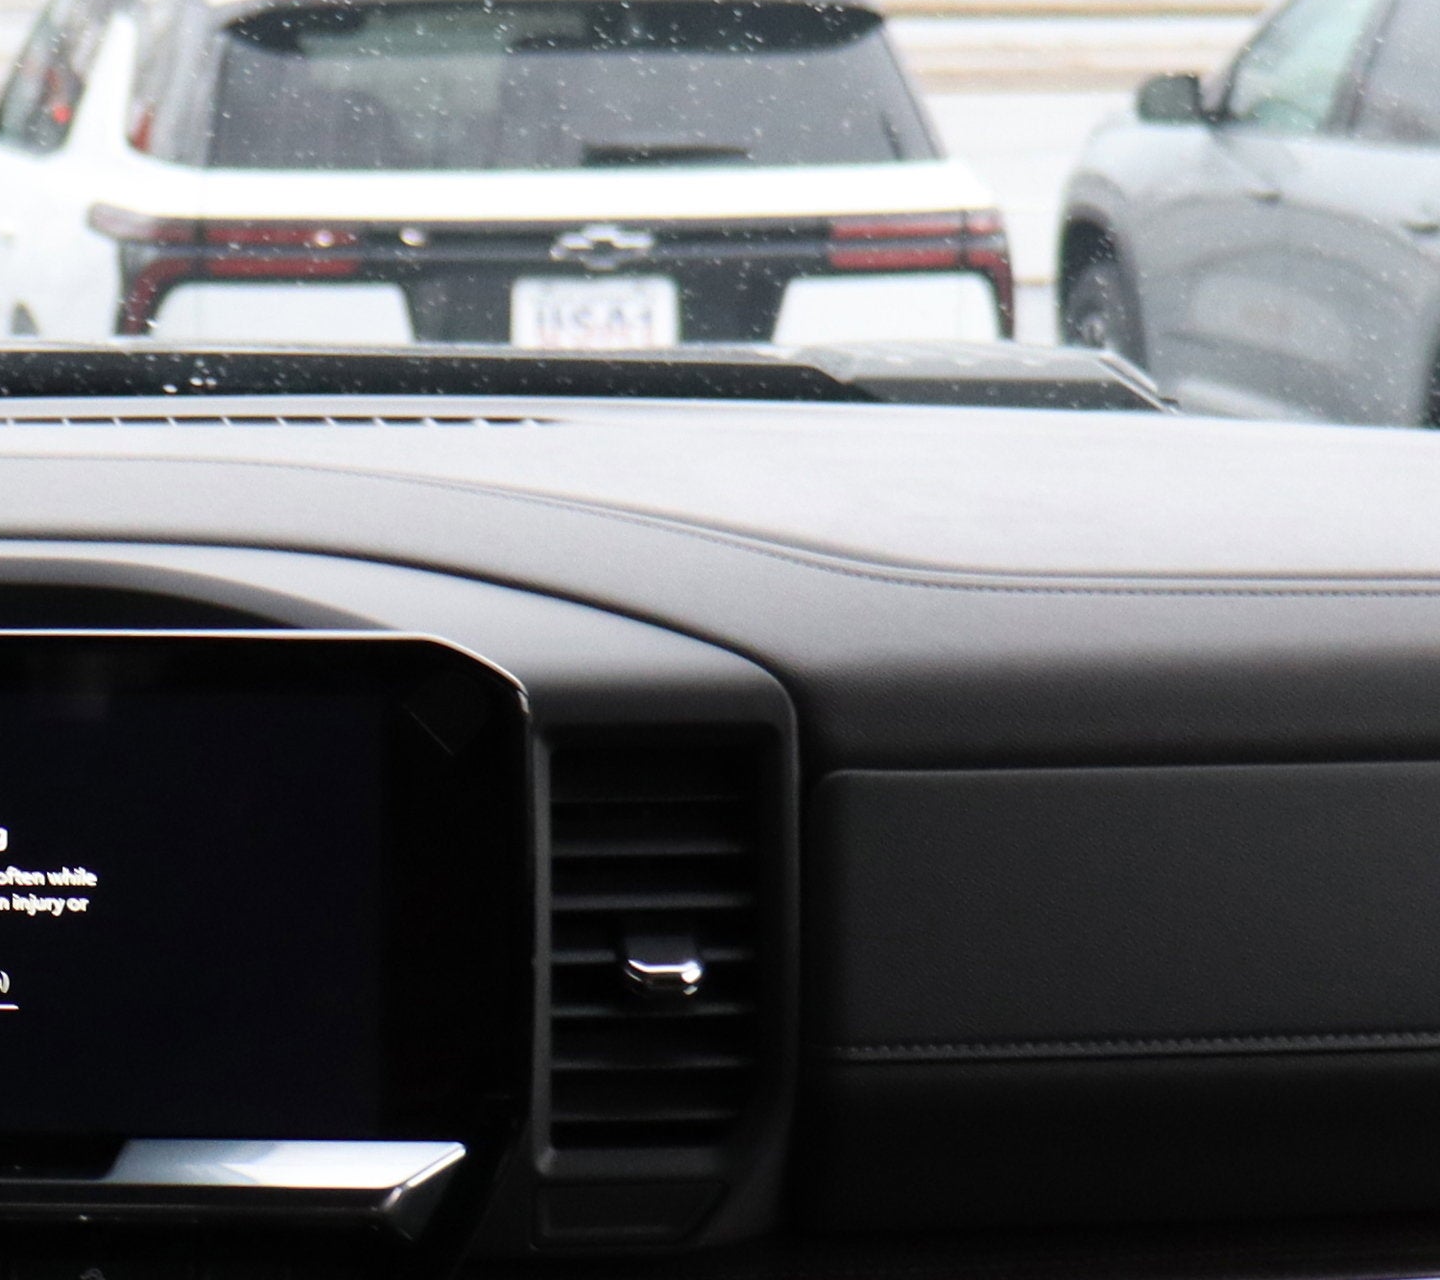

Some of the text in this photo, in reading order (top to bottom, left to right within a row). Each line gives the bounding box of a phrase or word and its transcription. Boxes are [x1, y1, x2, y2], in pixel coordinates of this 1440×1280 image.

[47, 866, 98, 887] while
[12, 893, 66, 916] injury
[67, 897, 90, 912] or
